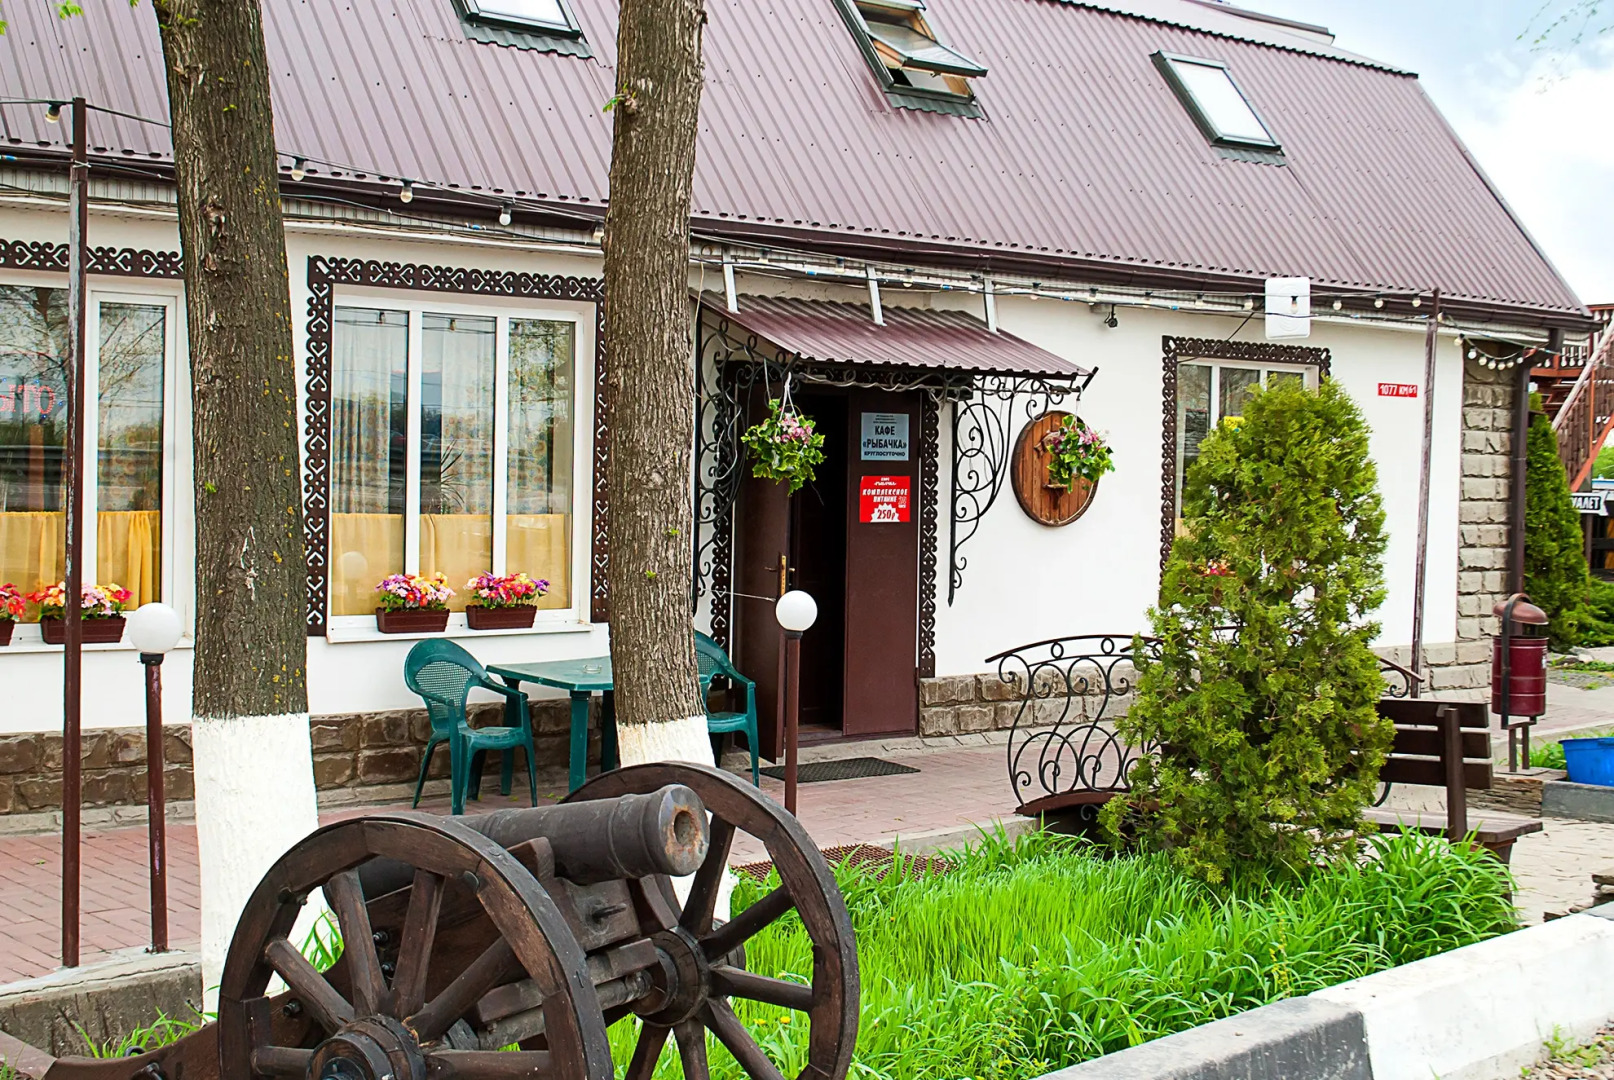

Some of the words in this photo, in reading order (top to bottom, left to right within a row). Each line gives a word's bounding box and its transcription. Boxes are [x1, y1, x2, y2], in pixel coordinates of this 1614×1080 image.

[1379, 384, 1398, 395] 1077
[875, 425, 895, 435] КАФЕ
[863, 438, 907, 449] «РЫБАЧКА»
[1569, 496, 1600, 510] УАЛЕТ
